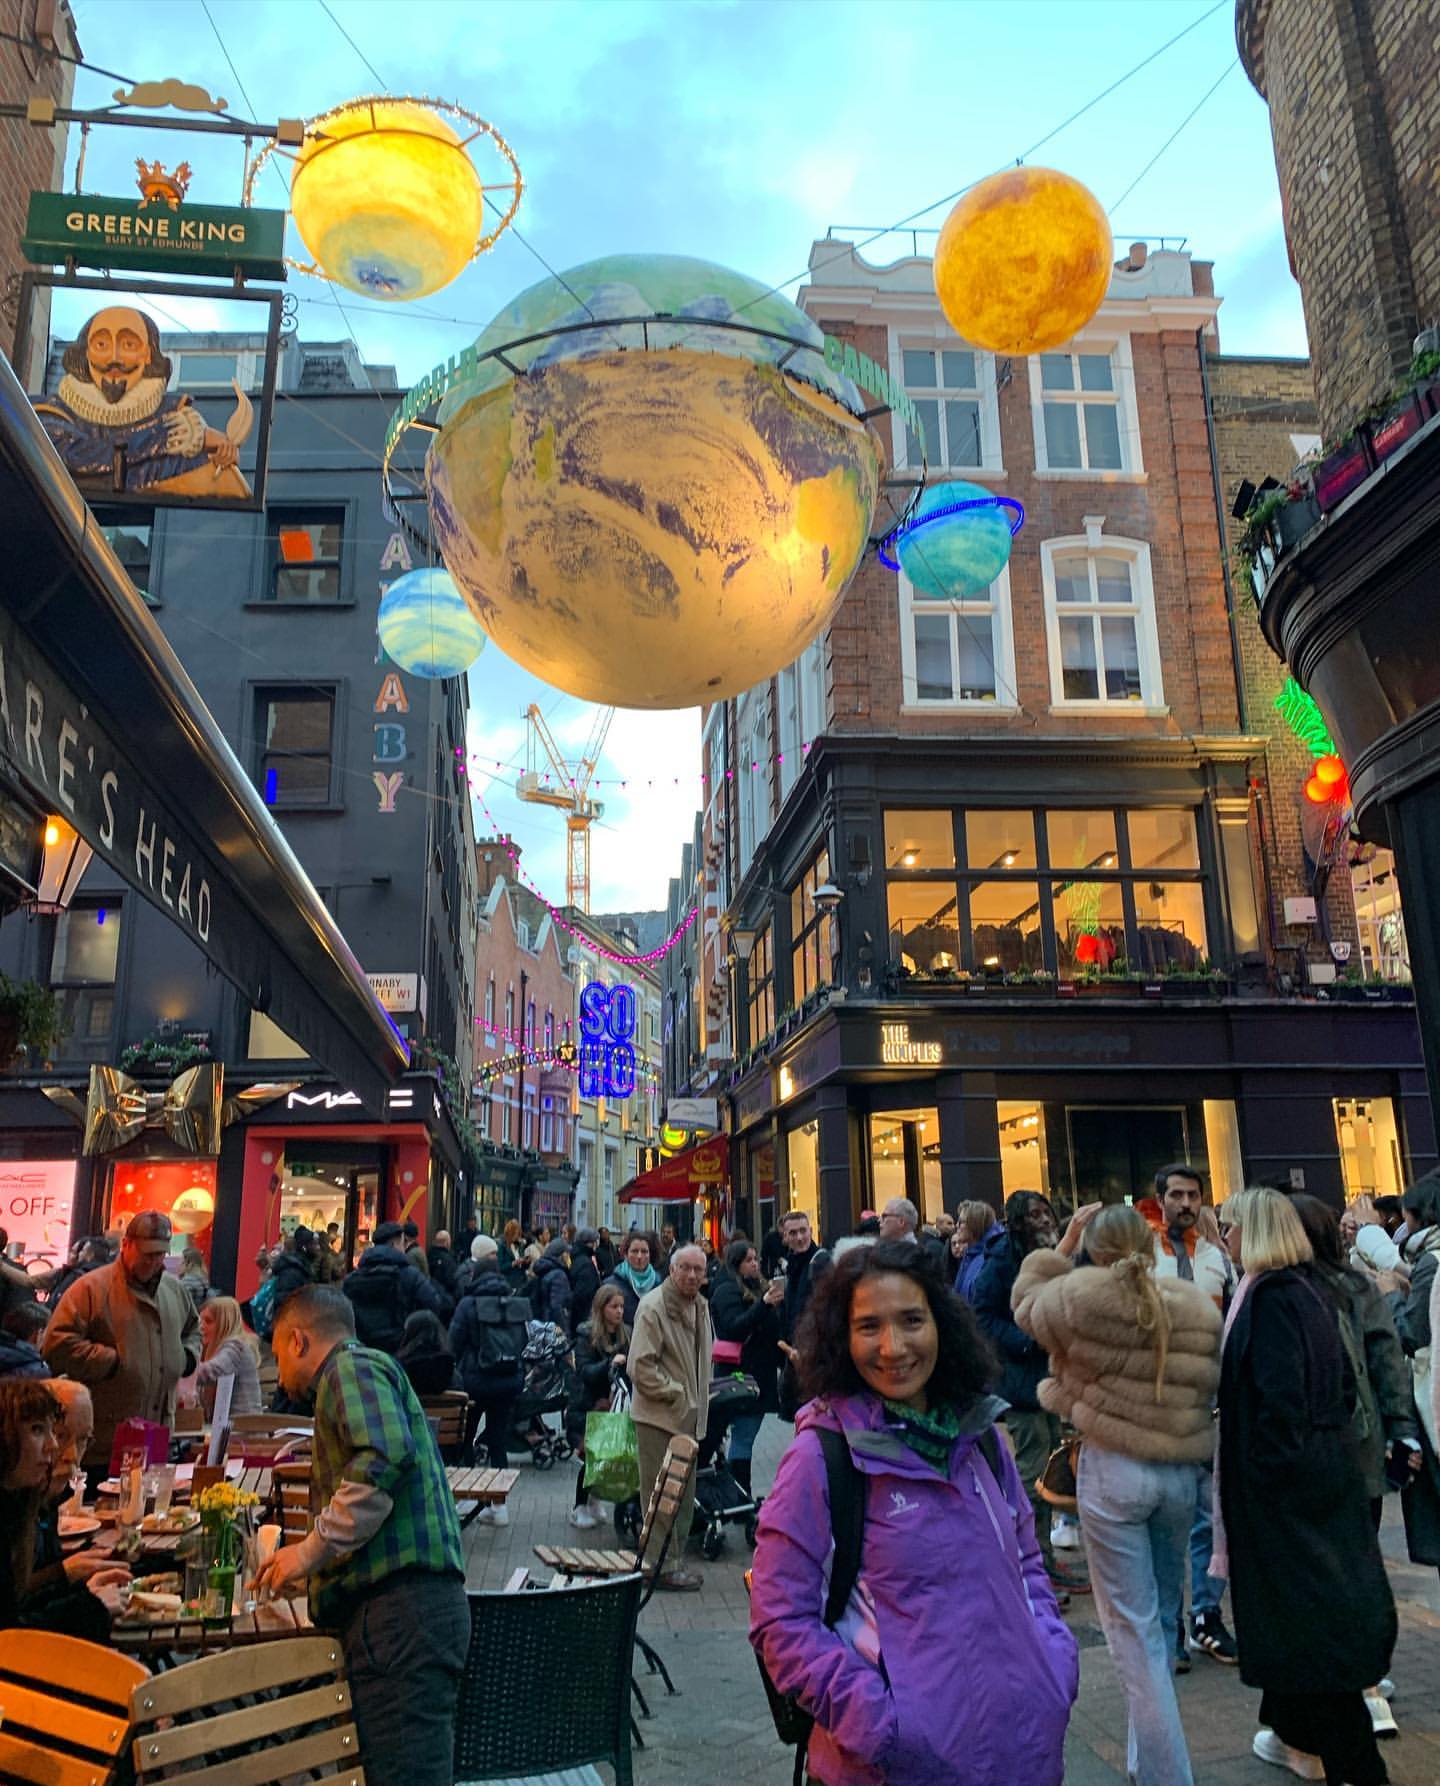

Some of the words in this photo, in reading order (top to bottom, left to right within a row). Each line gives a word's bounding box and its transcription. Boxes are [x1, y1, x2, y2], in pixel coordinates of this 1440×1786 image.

[66, 212, 169, 238] GREENE
[180, 220, 245, 243] KING
[135, 807, 211, 943] HEAD
[579, 981, 636, 1040] SO
[881, 1024, 909, 1043] THE
[578, 1038, 636, 1098] HO
[10, 1197, 56, 1217] OFF
